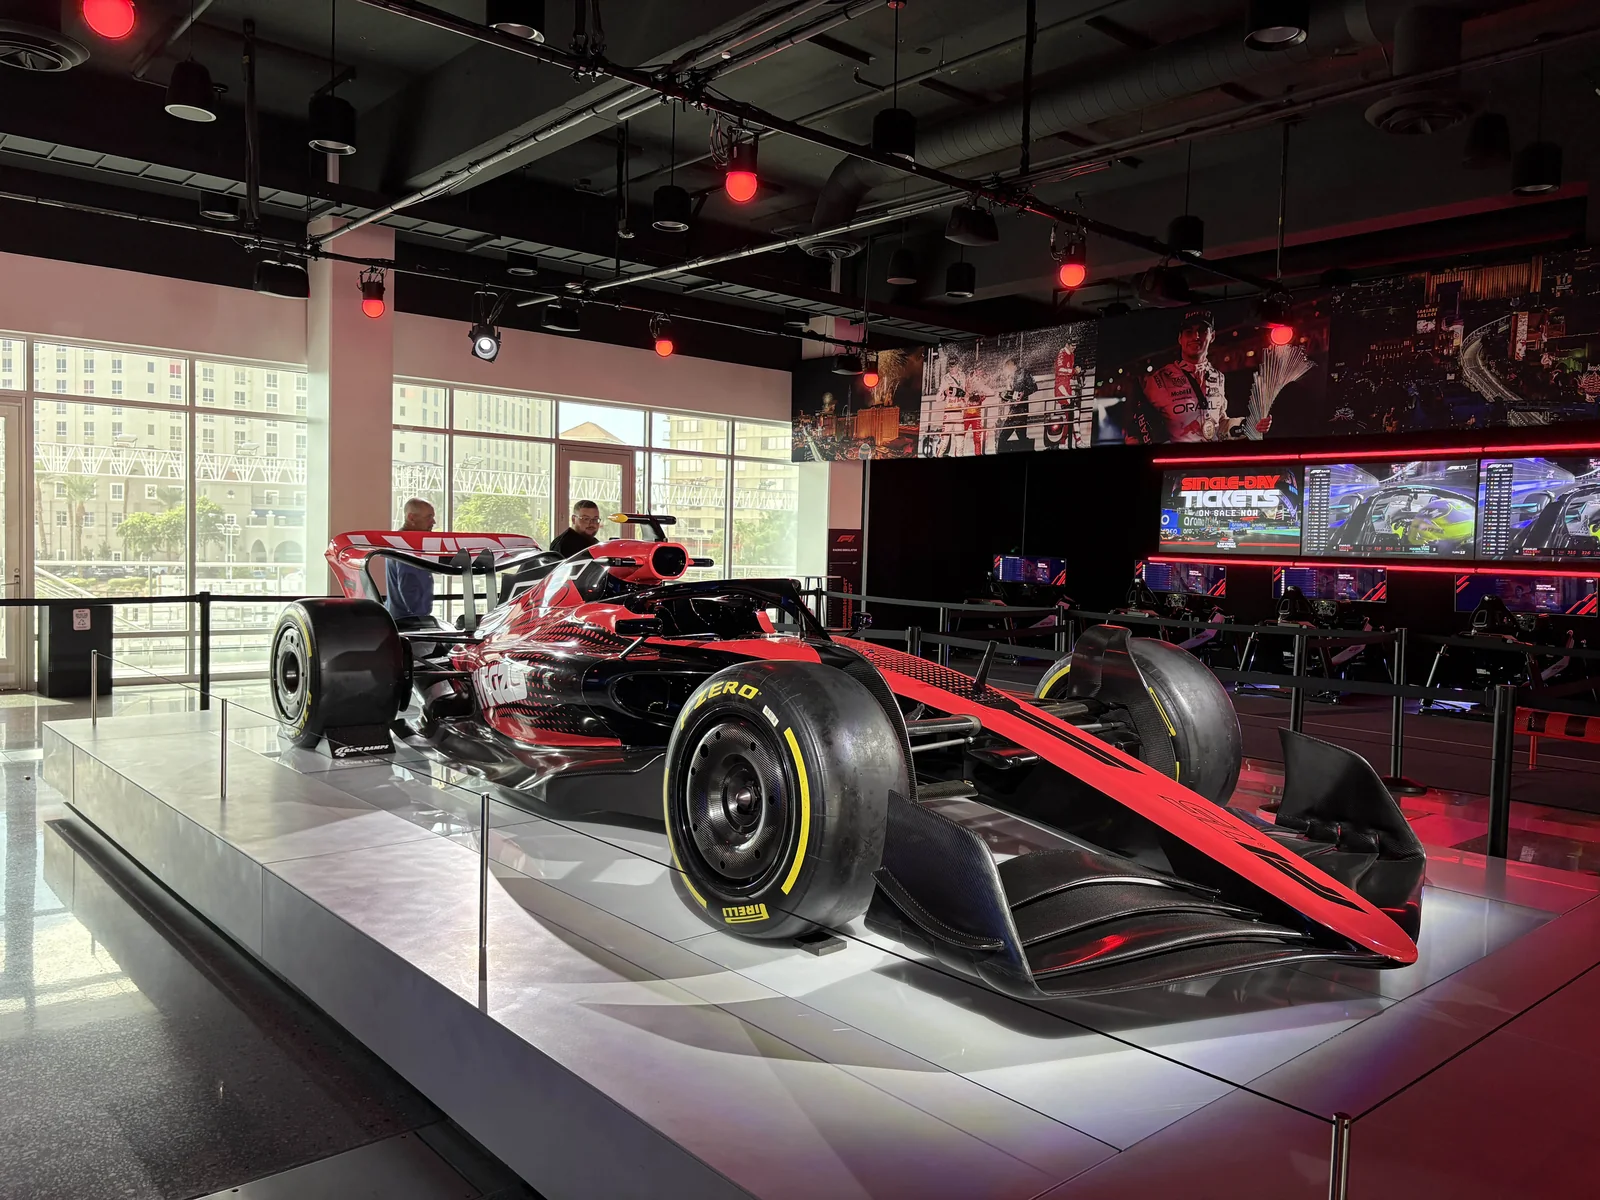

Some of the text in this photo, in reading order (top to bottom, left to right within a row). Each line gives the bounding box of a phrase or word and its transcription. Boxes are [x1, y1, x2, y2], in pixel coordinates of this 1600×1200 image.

[1181, 475, 1280, 491] SINGLE-DAY
[1180, 489, 1280, 508] TICKETS
[1199, 508, 1259, 517] ON SALE NOW
[693, 681, 760, 710] ZERO
[722, 903, 770, 924] PIRELLI
